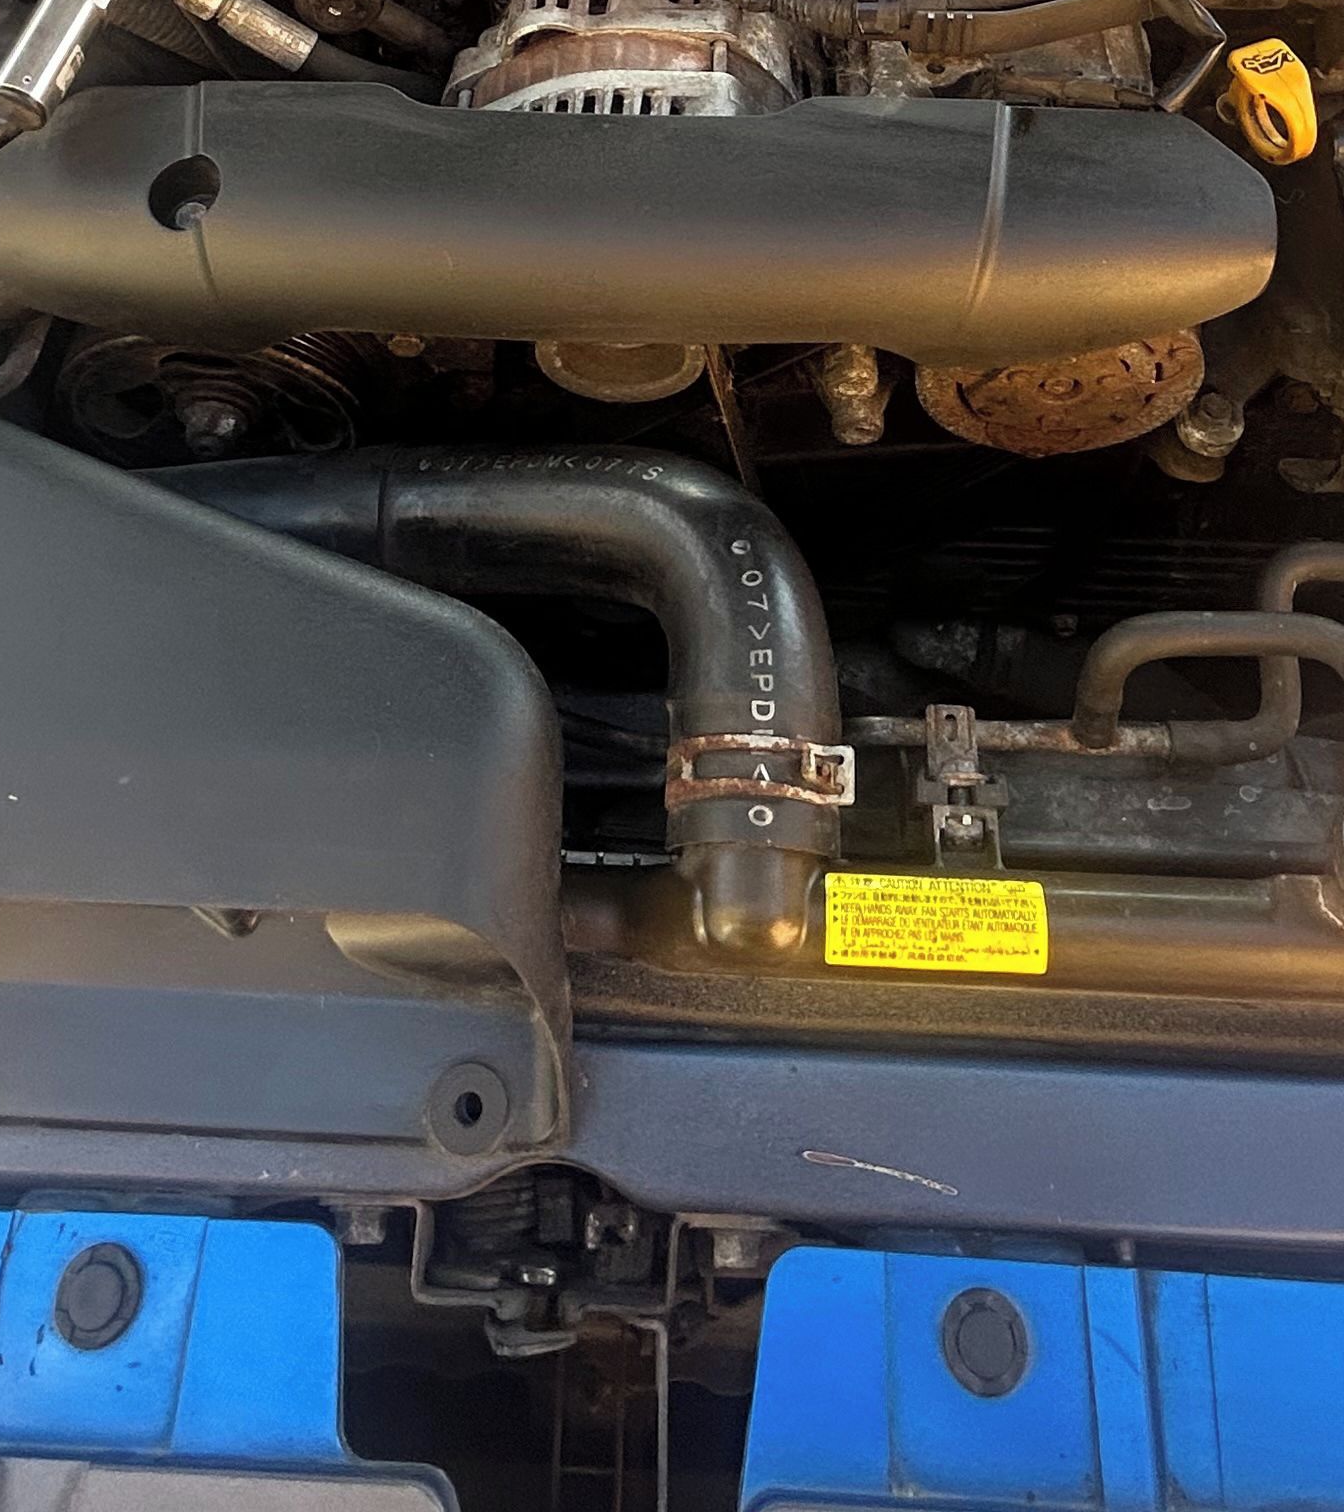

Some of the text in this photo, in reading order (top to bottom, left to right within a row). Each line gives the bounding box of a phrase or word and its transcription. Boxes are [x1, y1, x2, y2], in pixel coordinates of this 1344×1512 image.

[879, 878, 992, 895] CAUTION ATTENTION
[840, 903, 862, 914] KEEP
[863, 904, 894, 916] HANDS
[895, 905, 918, 916] AWAY
[940, 907, 970, 919] STARTS
